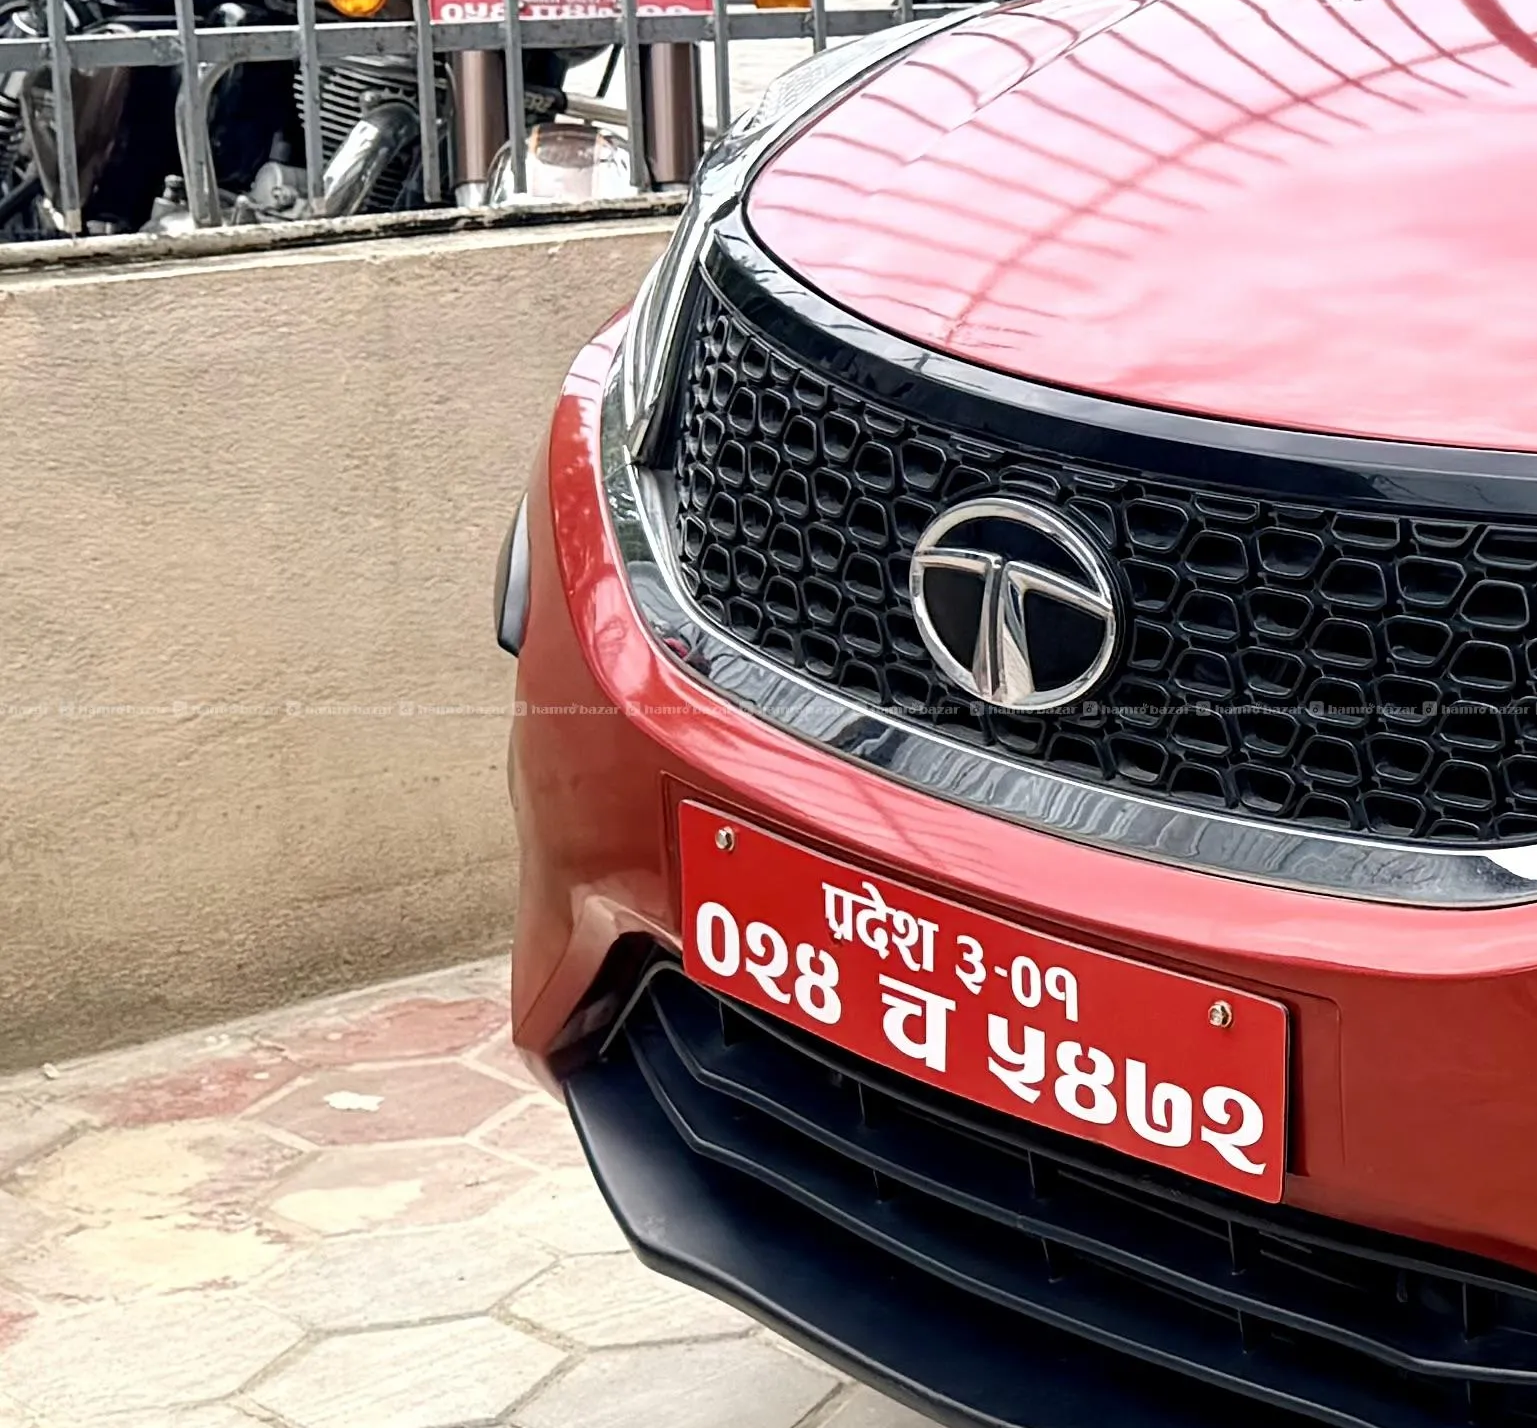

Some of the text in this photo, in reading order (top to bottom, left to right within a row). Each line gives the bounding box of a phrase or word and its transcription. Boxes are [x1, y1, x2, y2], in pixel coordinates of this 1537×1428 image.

[821, 880, 940, 974] प्रदेश
[695, 901, 1268, 1176] ०२४ च ५४७२
